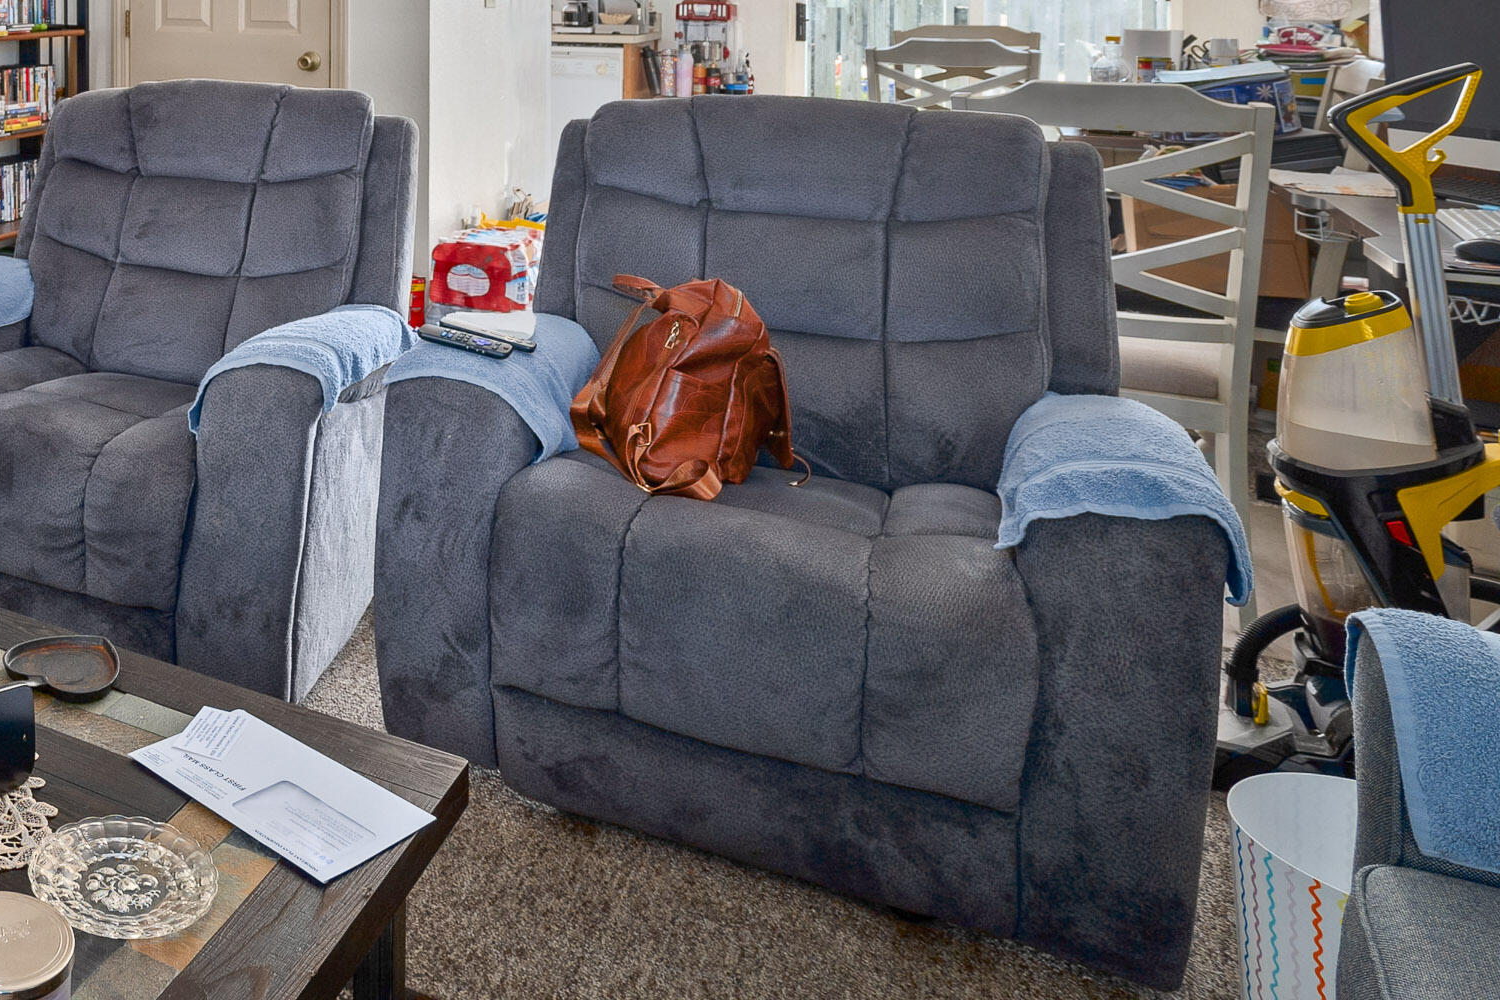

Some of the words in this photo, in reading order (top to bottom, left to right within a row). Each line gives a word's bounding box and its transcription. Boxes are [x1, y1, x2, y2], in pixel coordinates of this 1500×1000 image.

[183, 753, 199, 764] MAIL
[199, 763, 224, 778] CLASS
[223, 777, 246, 791] FIRST
